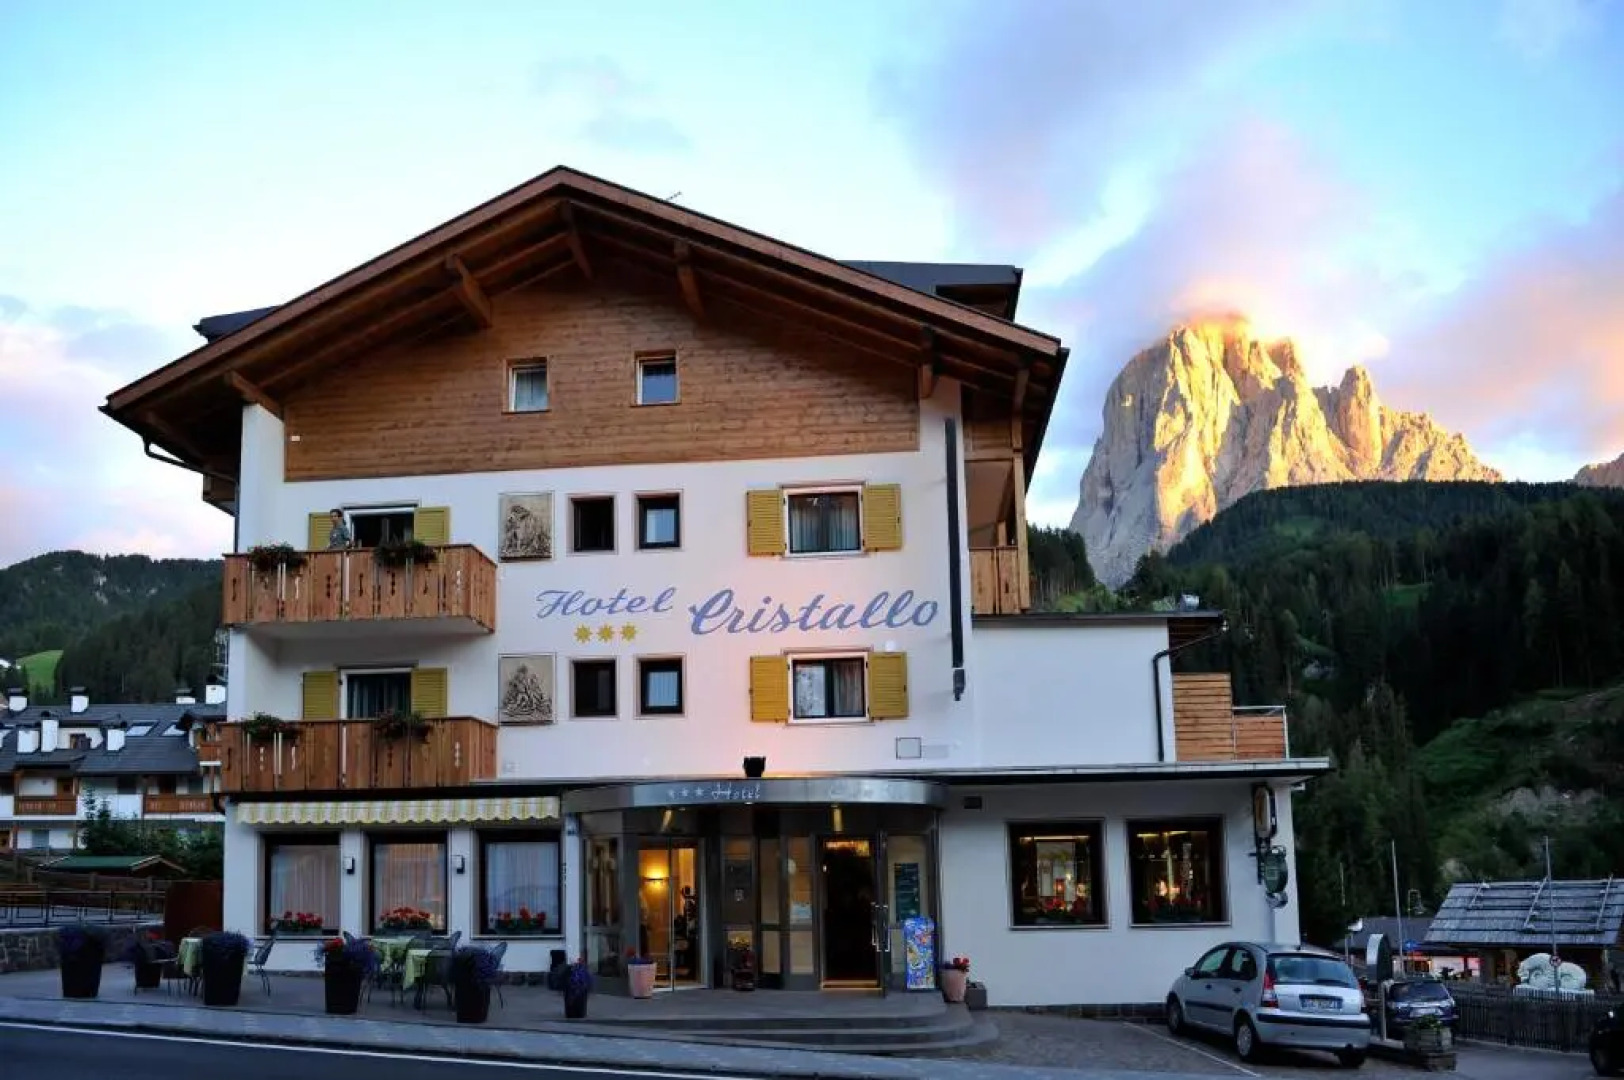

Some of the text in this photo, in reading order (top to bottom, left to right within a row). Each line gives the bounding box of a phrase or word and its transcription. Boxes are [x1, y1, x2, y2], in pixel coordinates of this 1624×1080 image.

[536, 587, 938, 635] Hotel Cristallo
[711, 780, 761, 799] Hotel
